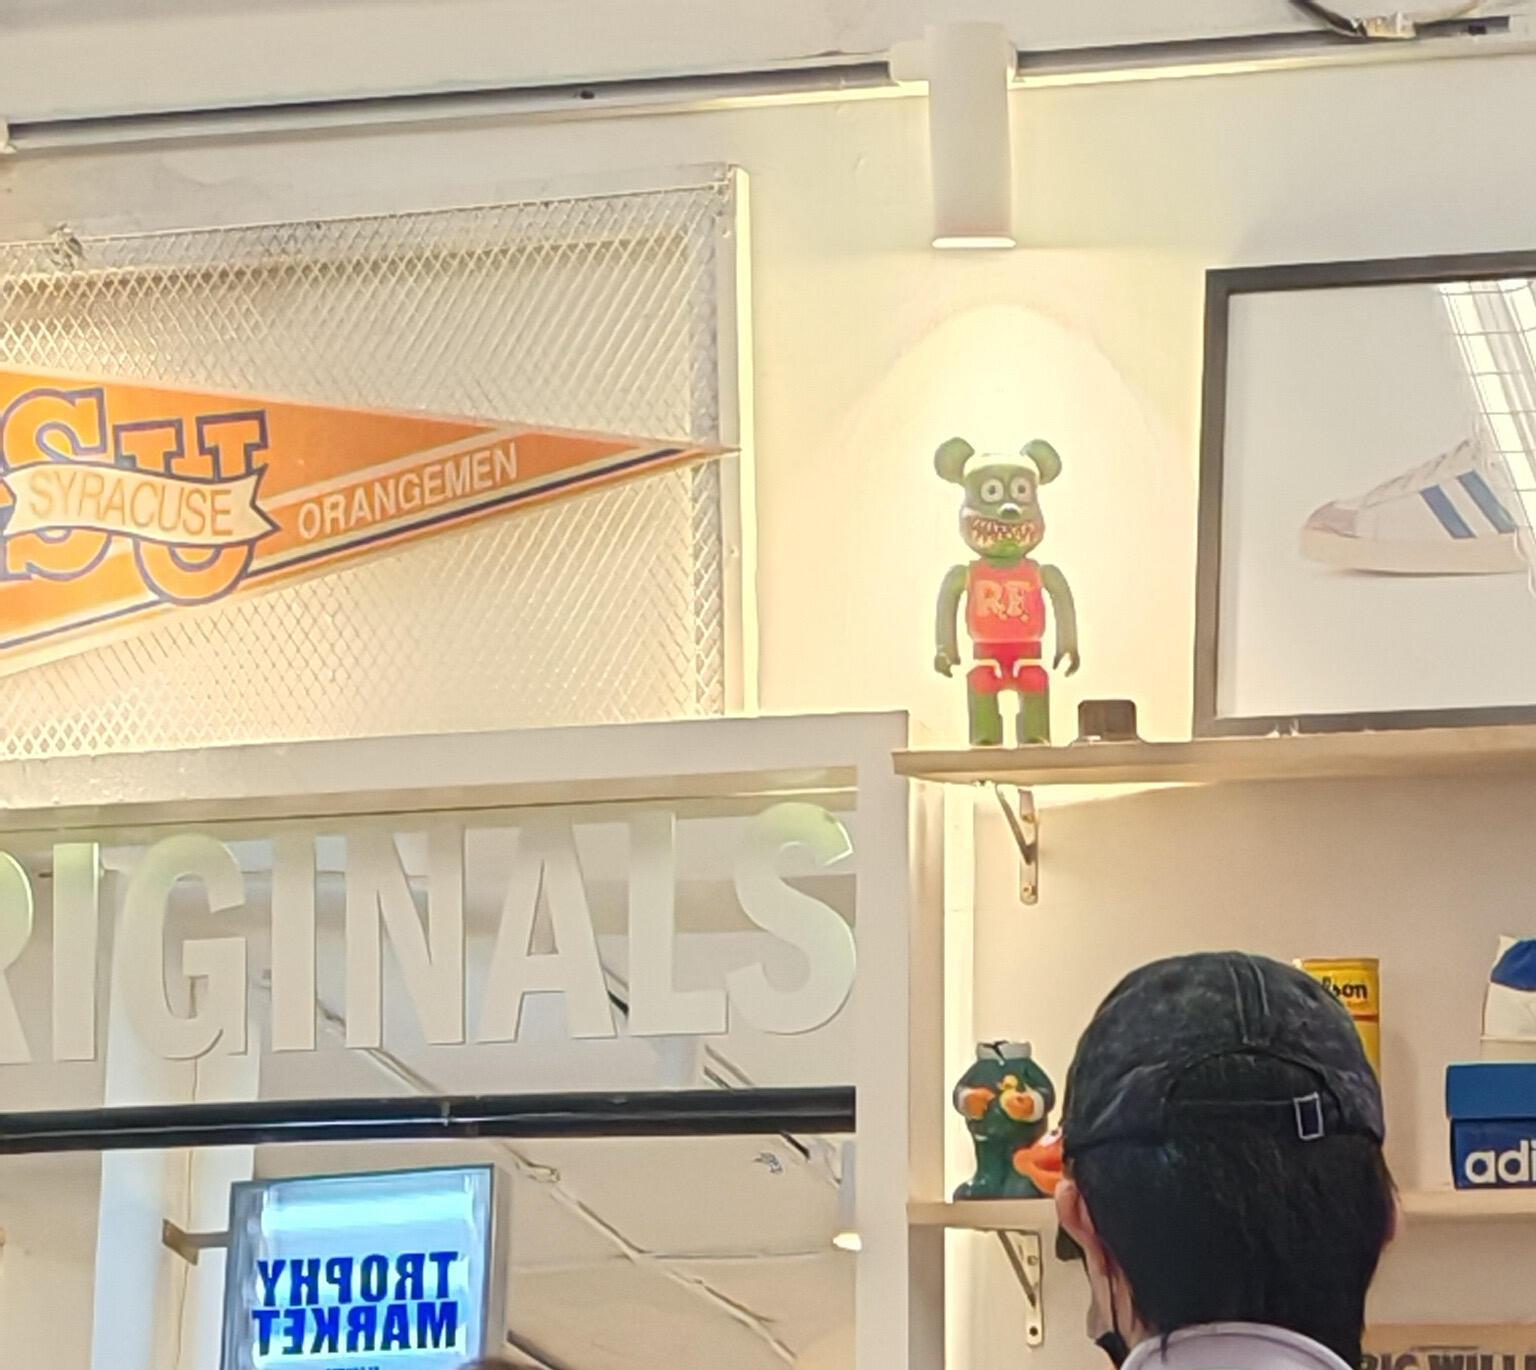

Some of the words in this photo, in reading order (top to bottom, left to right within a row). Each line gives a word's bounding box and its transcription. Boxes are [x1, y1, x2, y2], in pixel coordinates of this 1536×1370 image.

[28, 470, 235, 538] SYRACUSE
[298, 442, 519, 541] ORANGEMEN
[0, 802, 857, 1067] IGINALS
